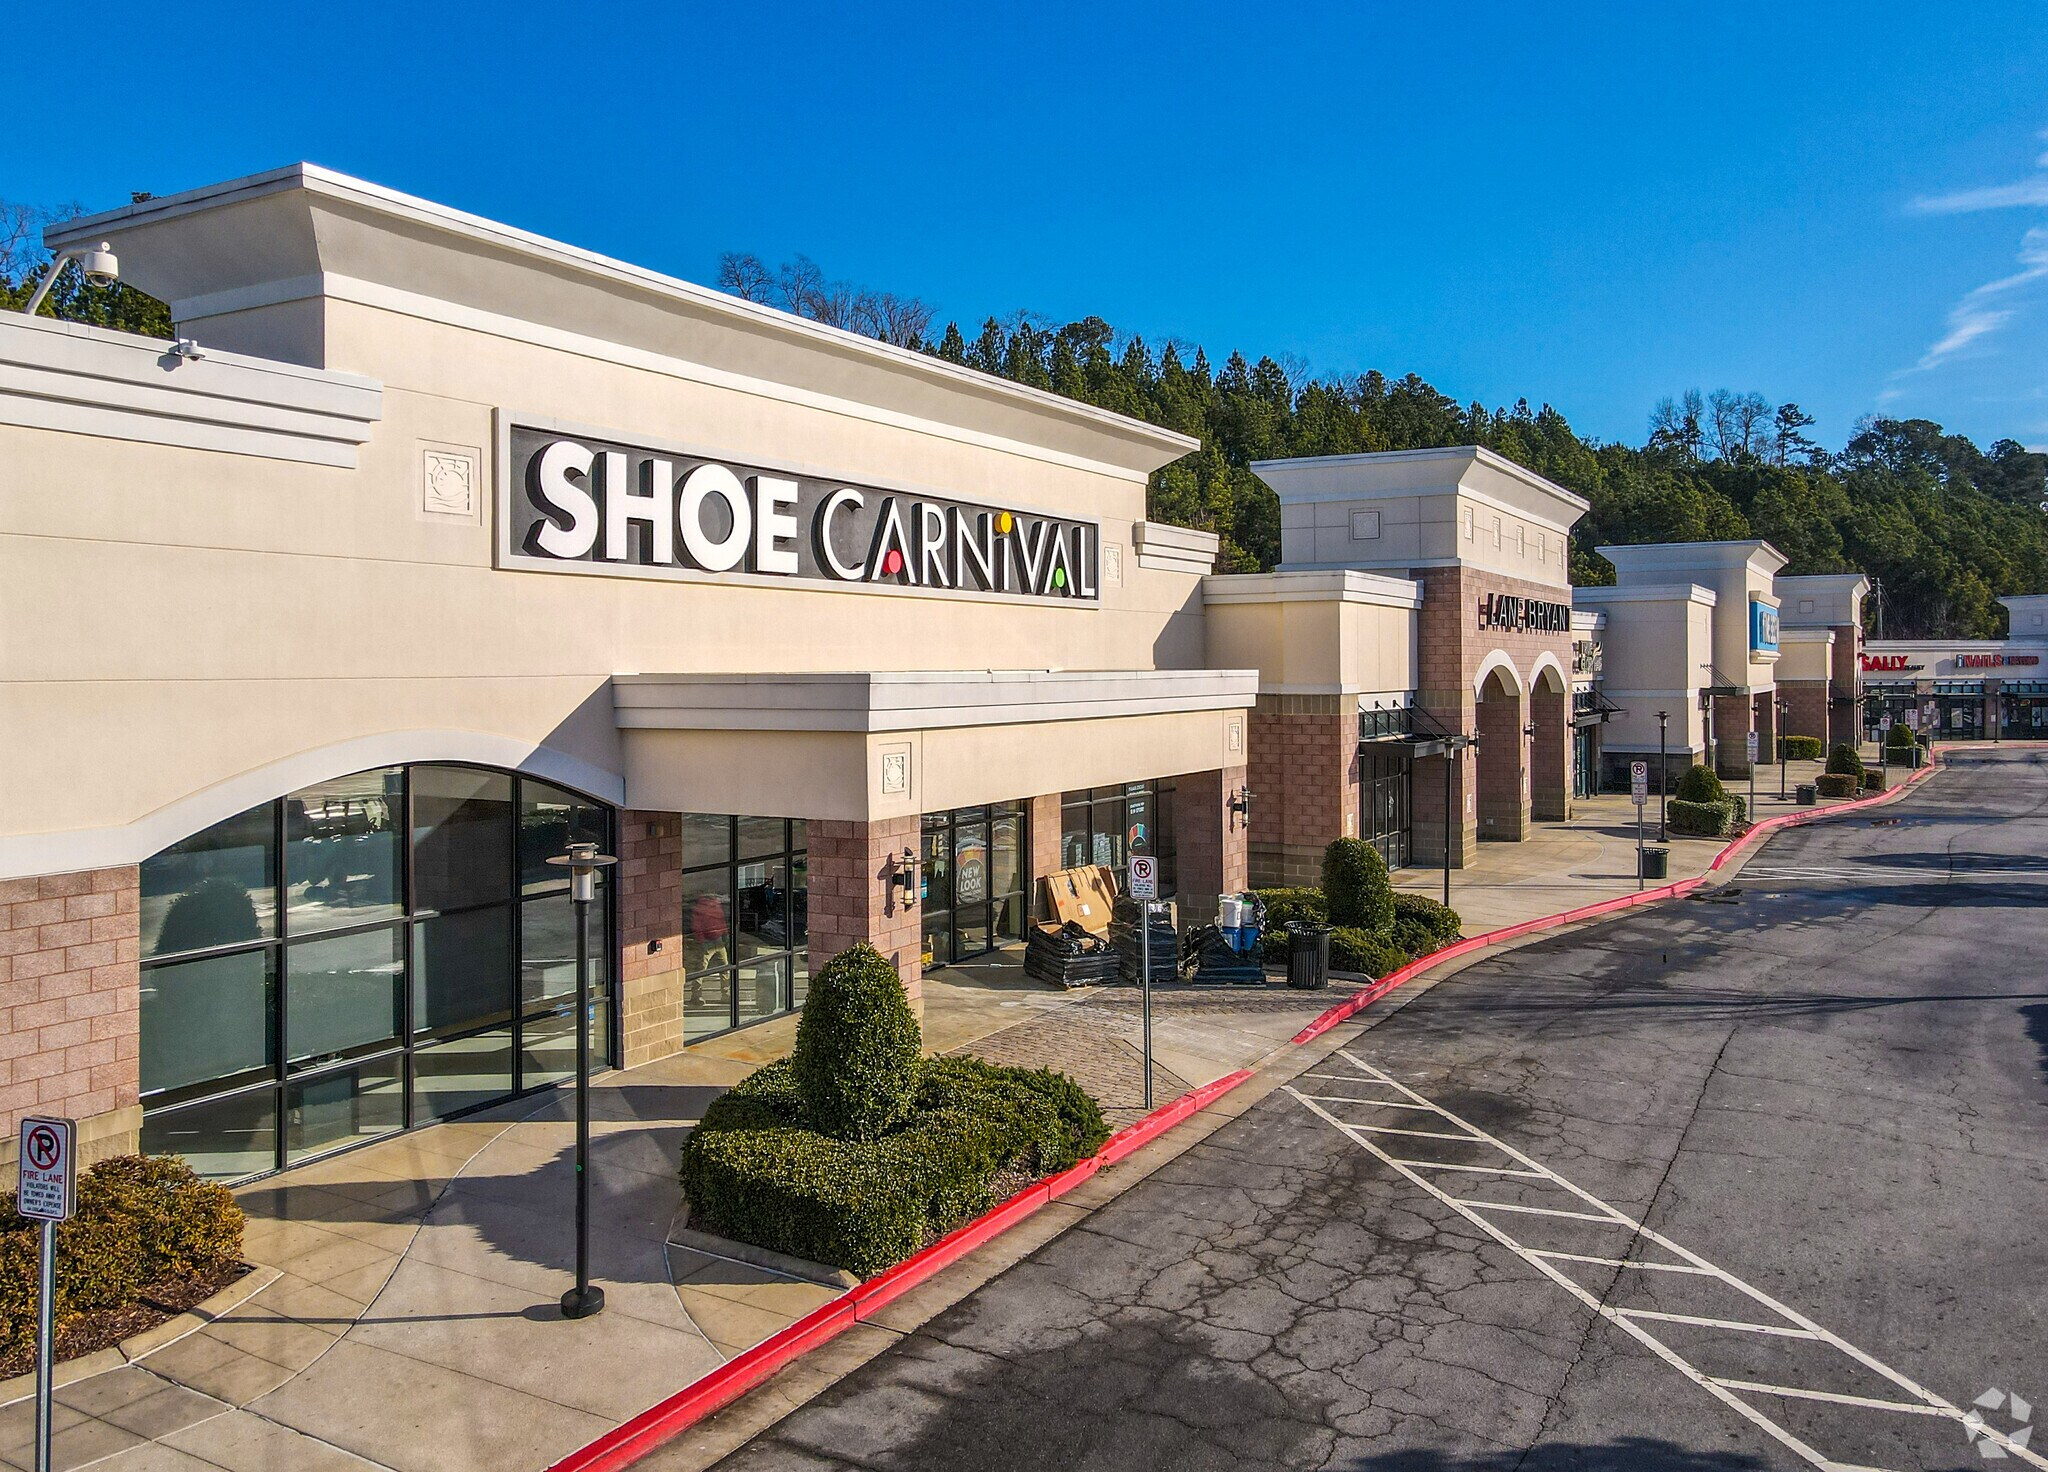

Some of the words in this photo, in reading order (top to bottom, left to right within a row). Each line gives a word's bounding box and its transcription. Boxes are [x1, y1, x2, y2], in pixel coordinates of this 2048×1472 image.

[530, 440, 798, 574] SHOE
[1488, 593, 1525, 628] LANE
[1862, 655, 1908, 671] SALLY
[962, 866, 980, 880] NEW
[960, 877, 981, 892] LOOK
[23, 1170, 39, 1180] FIRE
[43, 1173, 63, 1184] LANE
